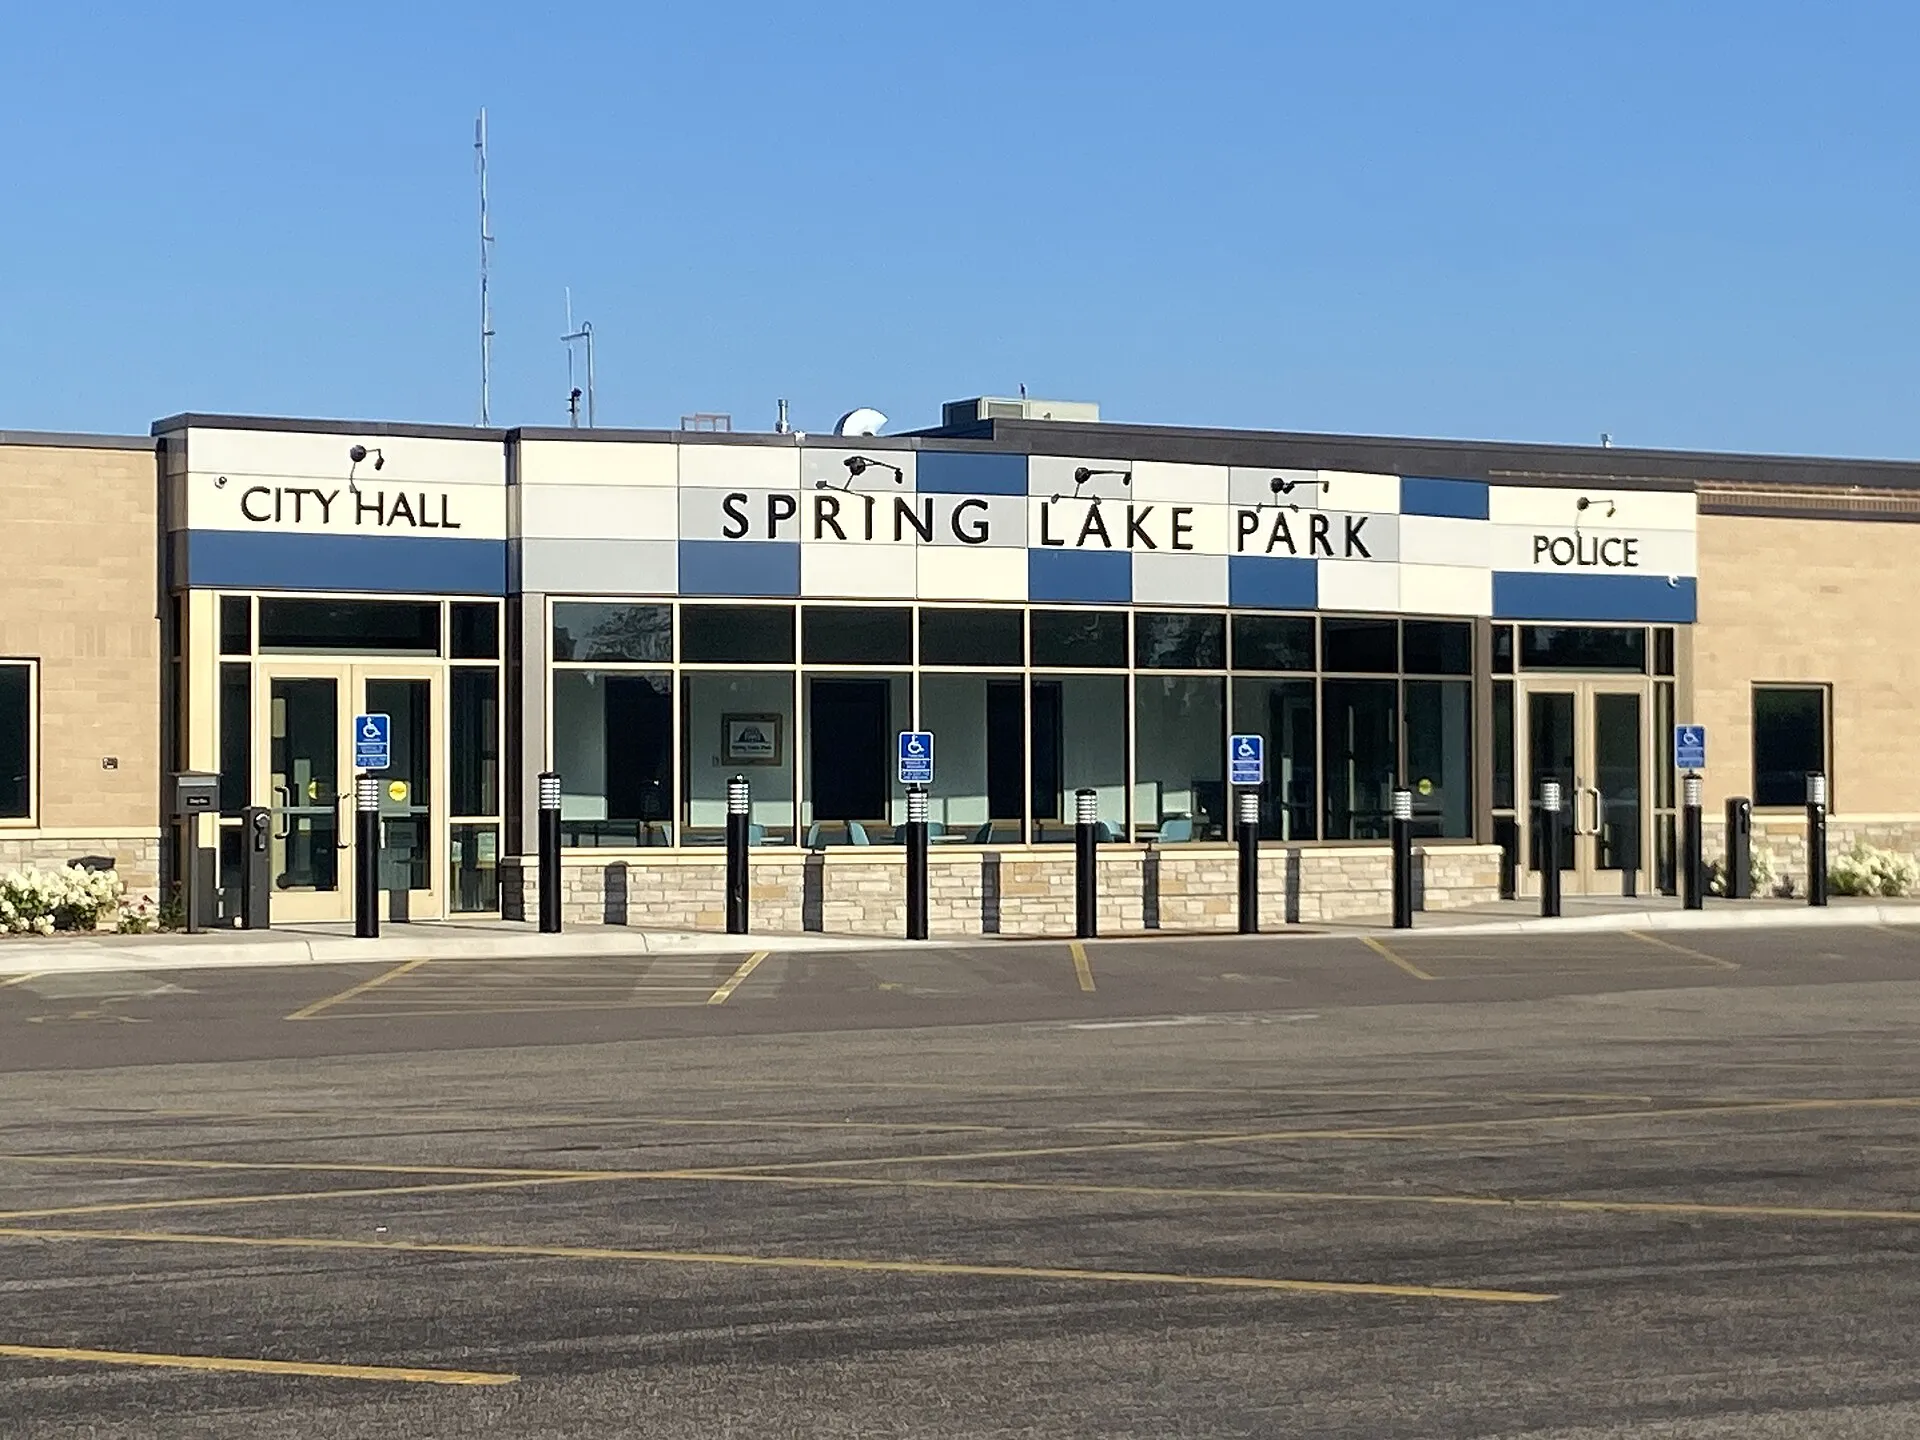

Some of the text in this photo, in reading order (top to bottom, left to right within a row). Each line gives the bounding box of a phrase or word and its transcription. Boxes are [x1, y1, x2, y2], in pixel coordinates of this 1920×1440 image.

[241, 486, 461, 529] CITY HALL
[722, 492, 1372, 559] SPRING LAKE PARK
[1534, 535, 1639, 567] POLICE
